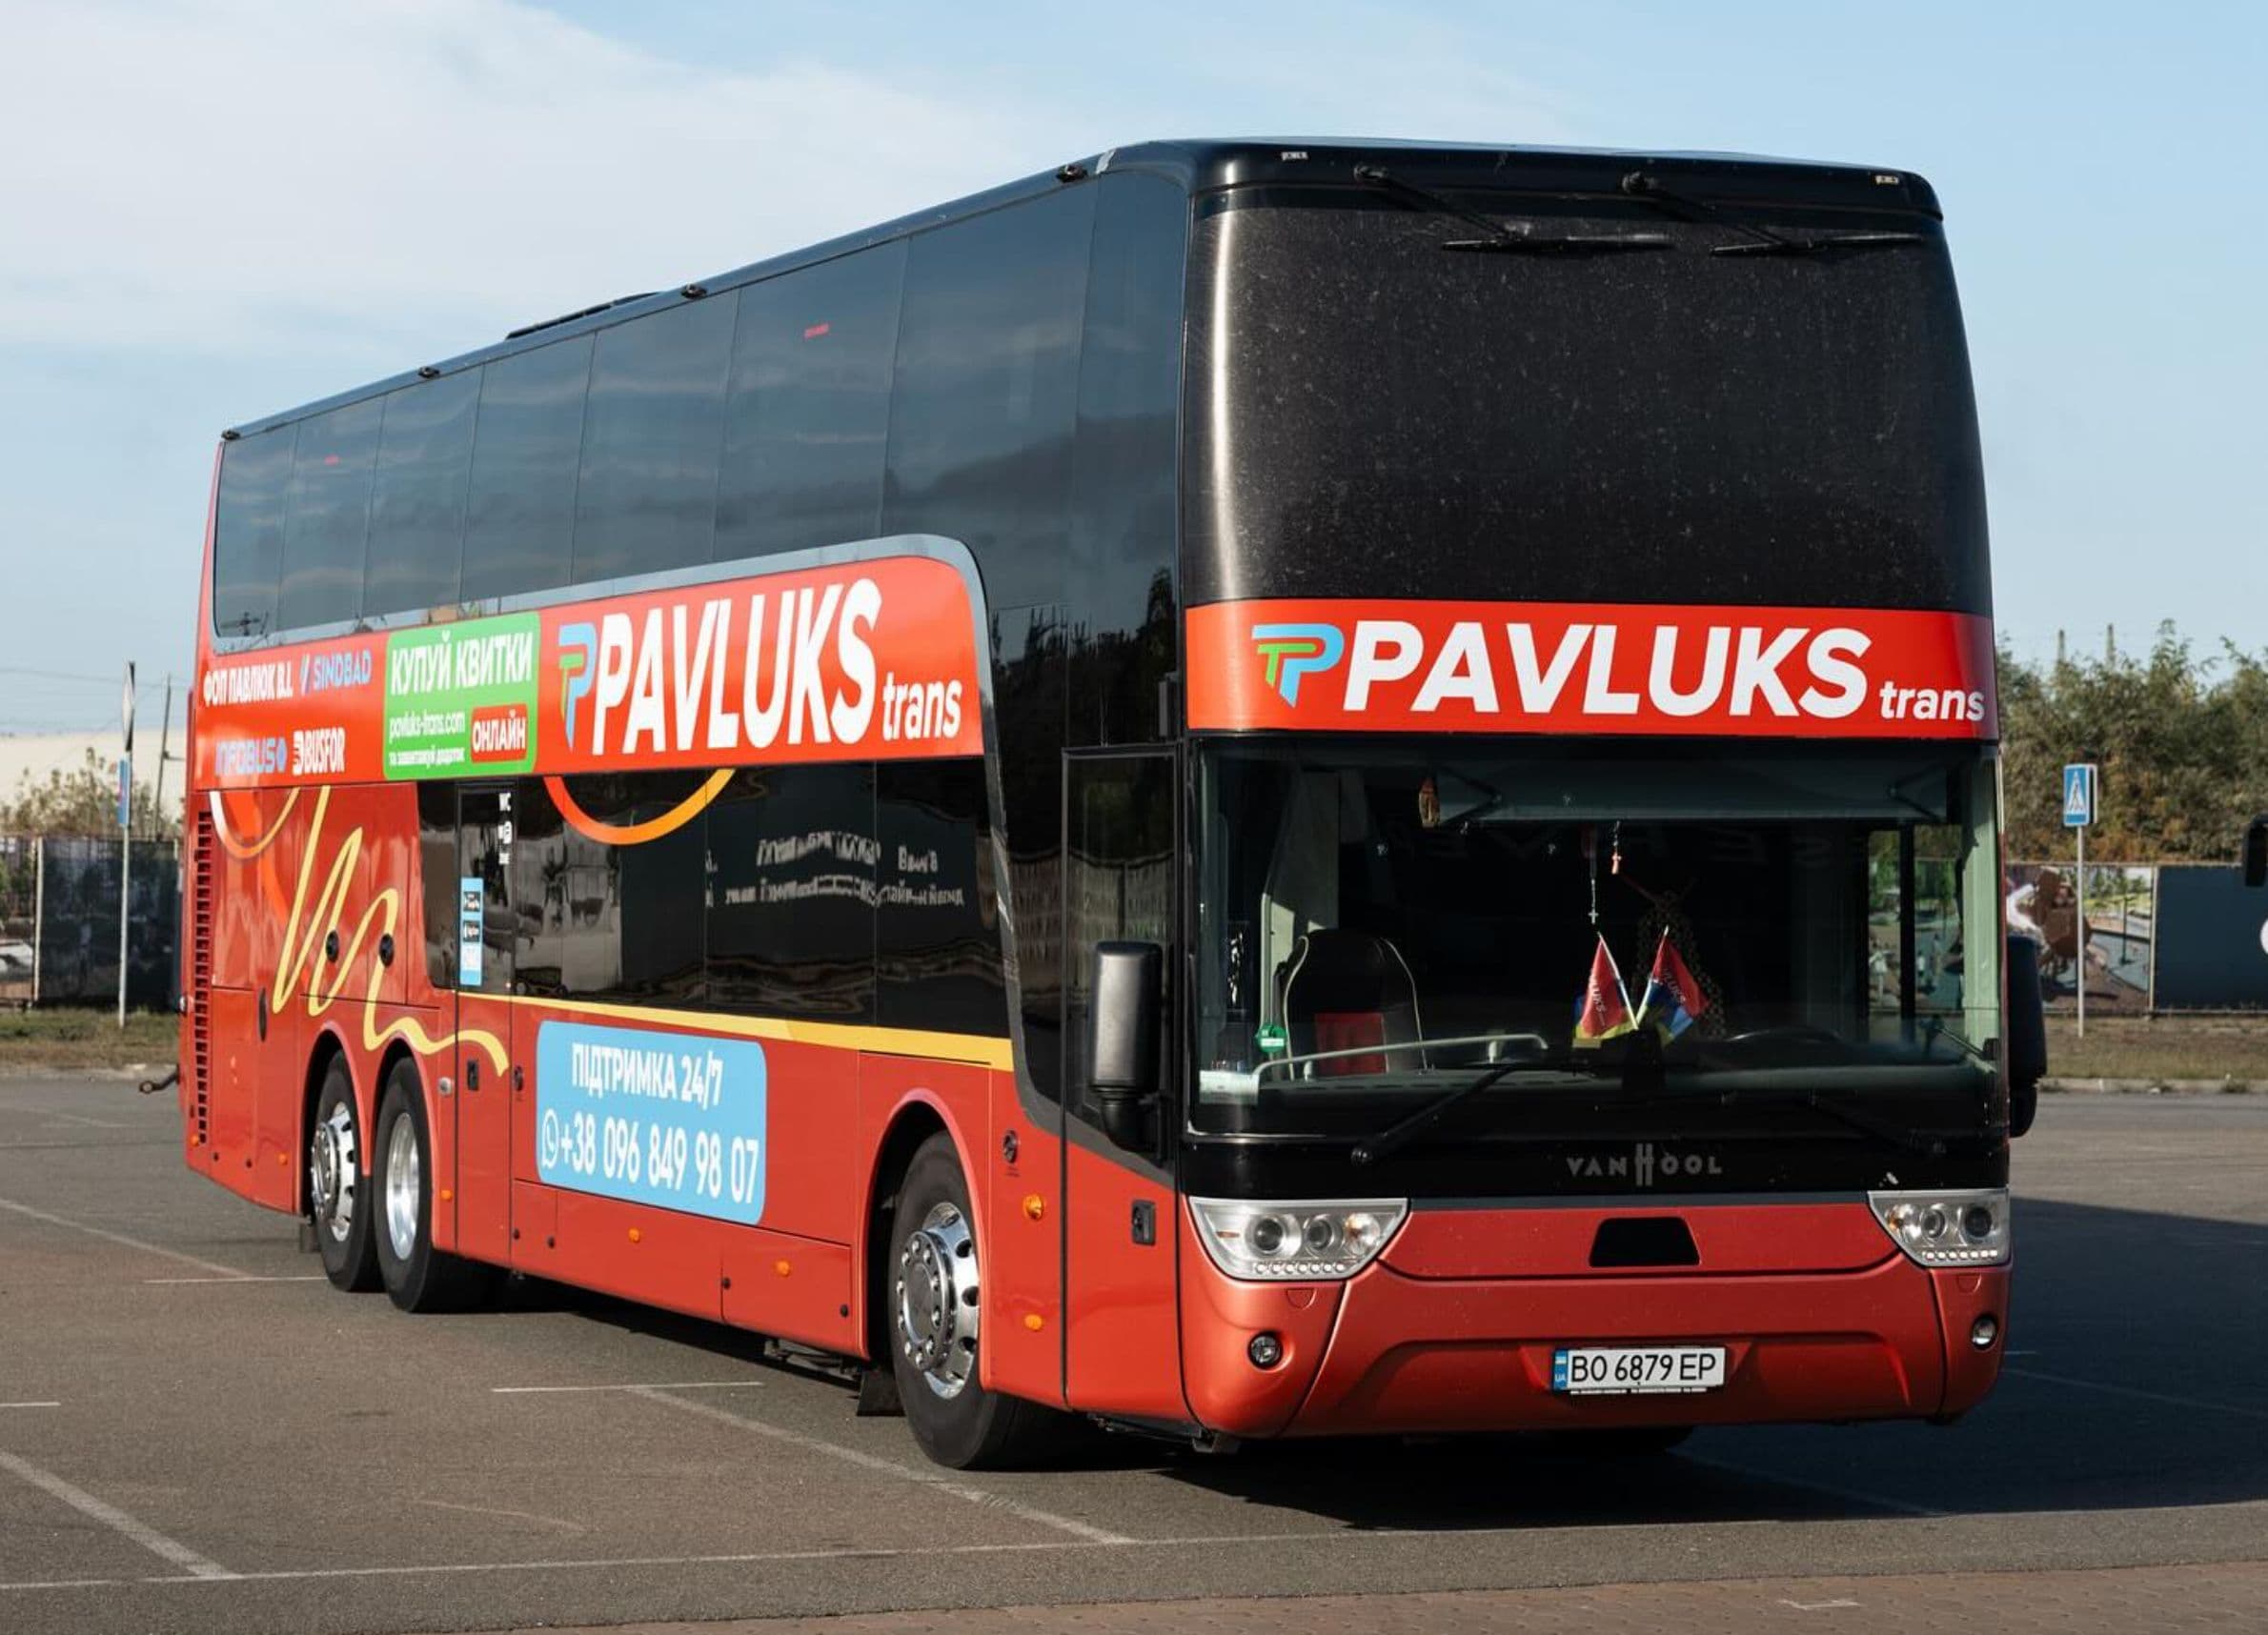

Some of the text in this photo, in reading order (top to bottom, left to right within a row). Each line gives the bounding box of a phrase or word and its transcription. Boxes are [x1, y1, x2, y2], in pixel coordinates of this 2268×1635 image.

[314, 649, 373, 692] SINDBAD
[391, 632, 532, 696] КУПУЙ КВИТКИ
[592, 577, 881, 756] PAVLUKS
[881, 671, 962, 742] trans
[1343, 620, 1873, 719] PAVLUKS
[1879, 679, 1986, 724] trans
[473, 709, 527, 753] ОНЛАЙН
[572, 1042, 723, 1110] ПІДТРИМКА 24/7
[561, 1111, 759, 1204] +38 096 849 98 07
[1571, 1353, 1716, 1383] BO 6879 EP
